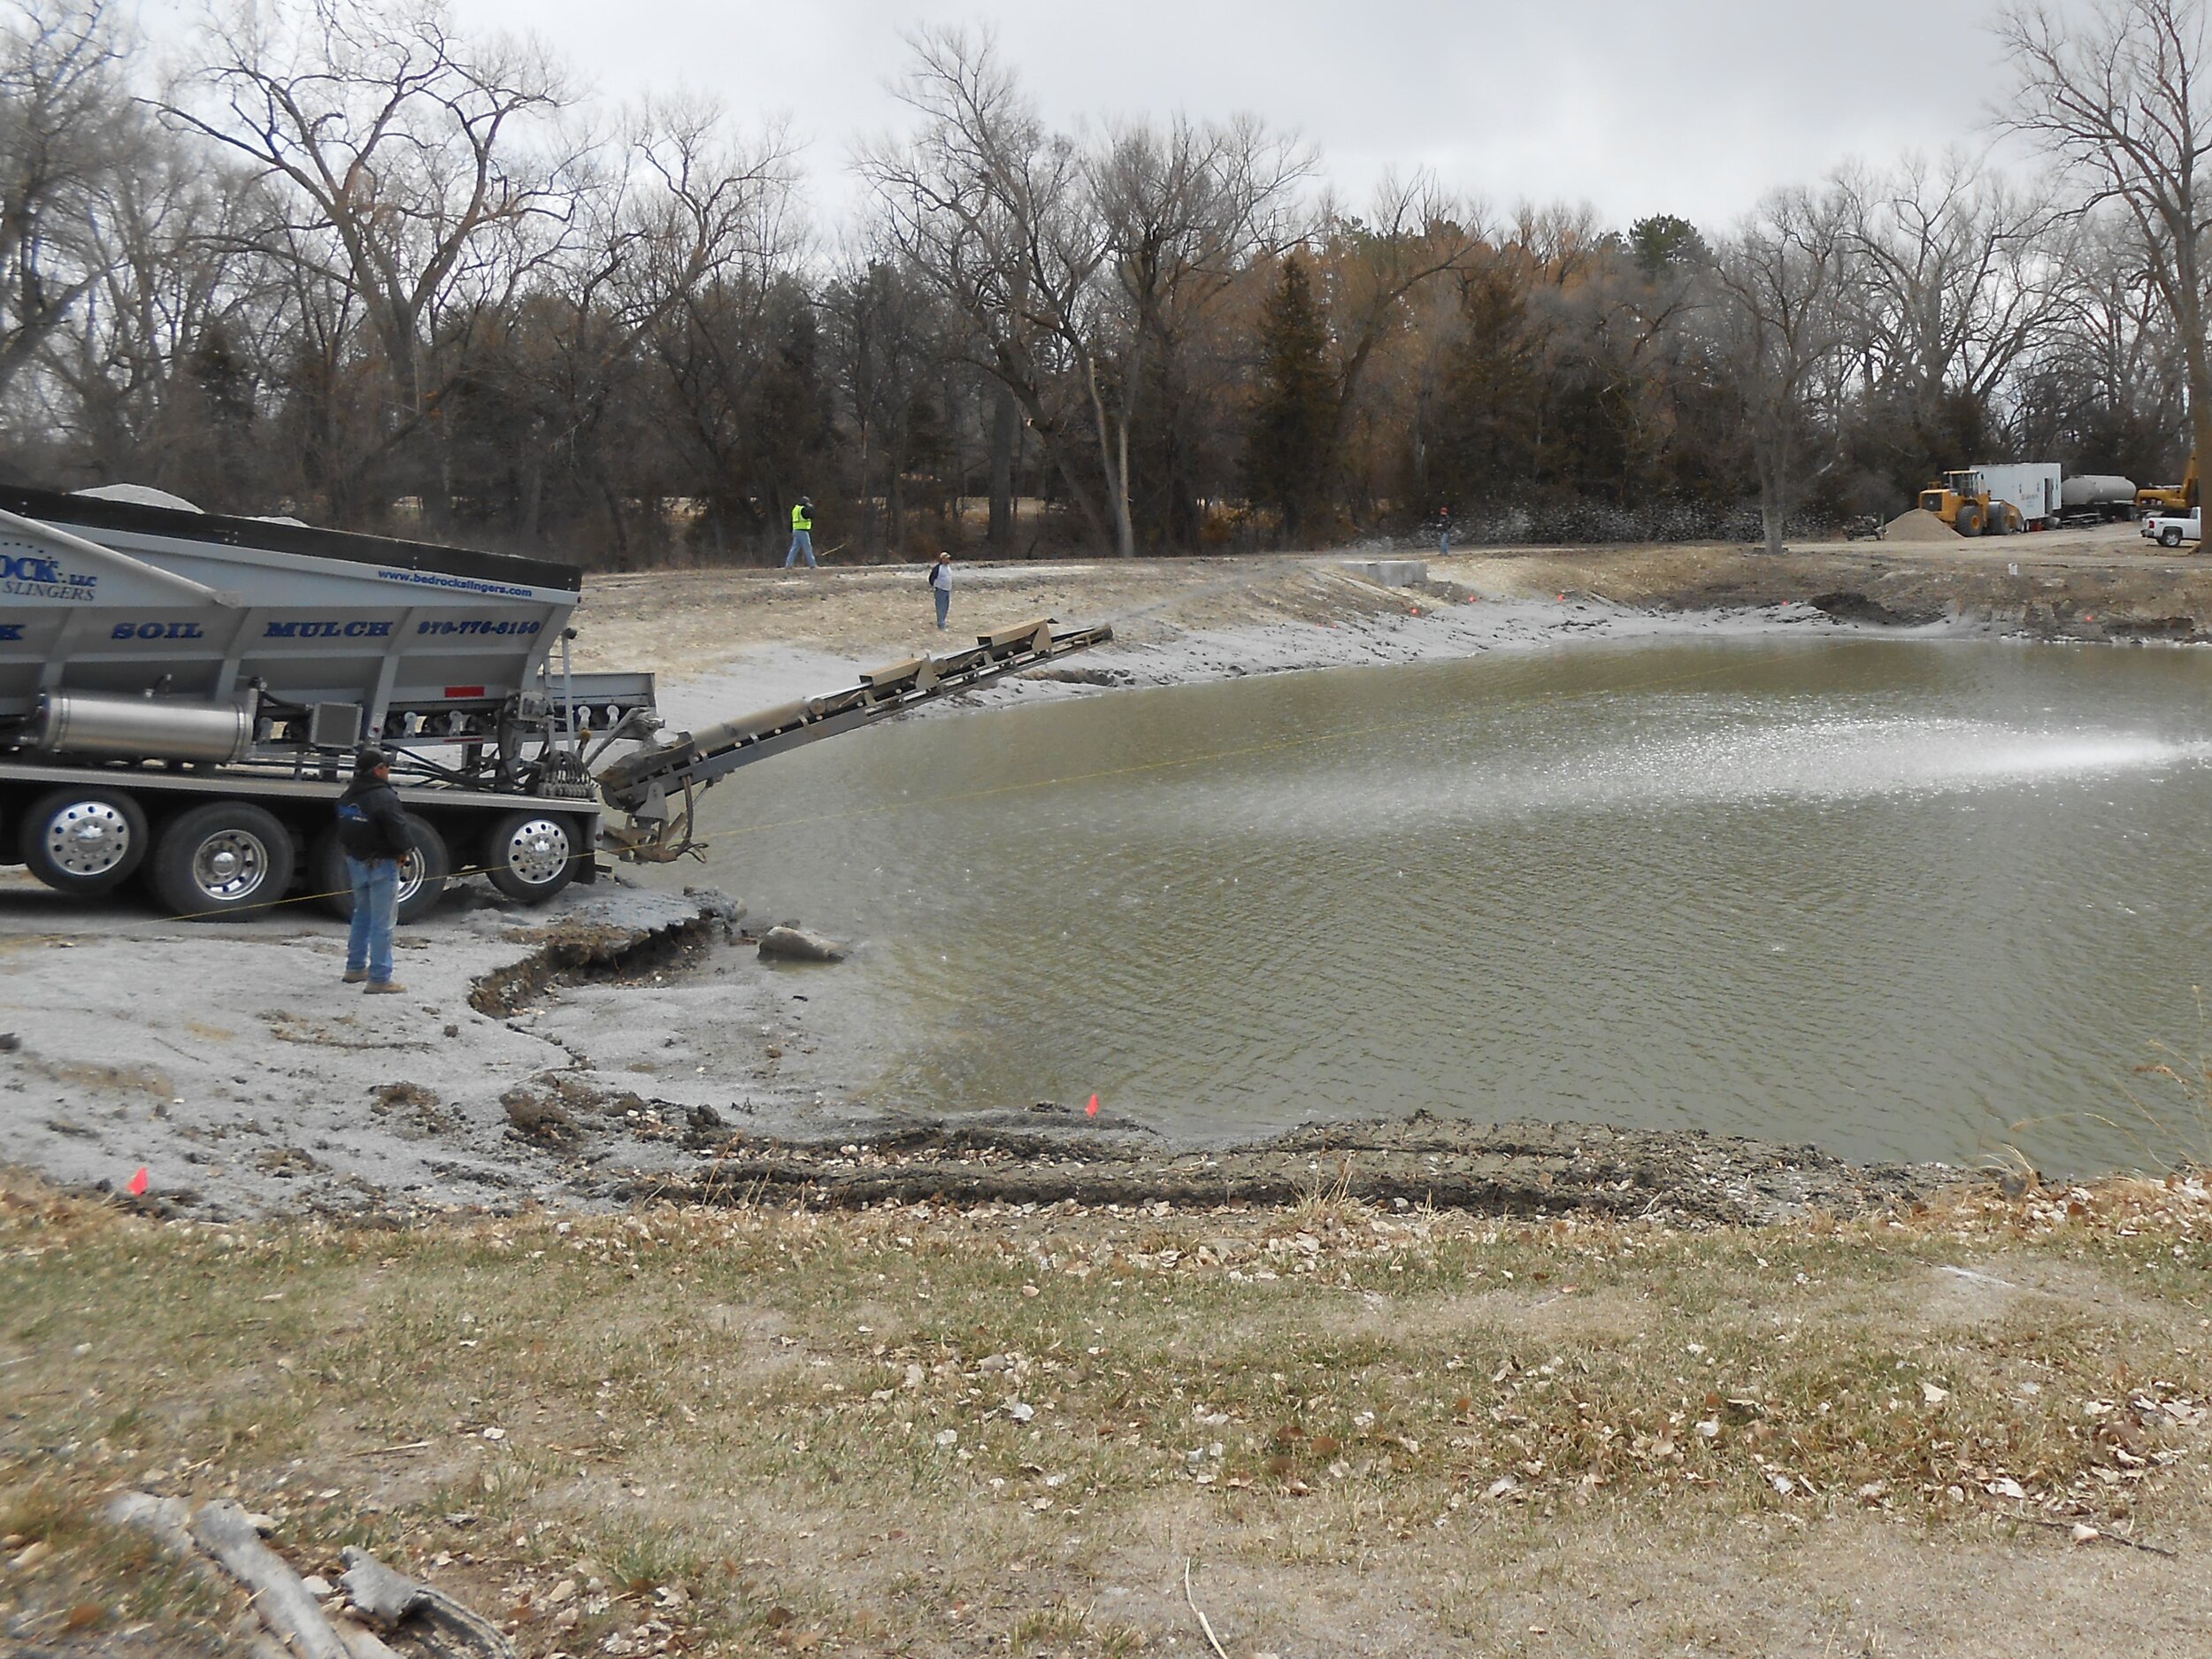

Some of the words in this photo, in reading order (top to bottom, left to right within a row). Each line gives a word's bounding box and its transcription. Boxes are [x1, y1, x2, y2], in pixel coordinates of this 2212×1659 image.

[70, 574, 97, 587] LLC
[378, 571, 532, 597] www.bedrockslingers.com
[3, 580, 96, 601] SLINGERS
[111, 622, 204, 639] SOIL
[263, 621, 394, 638] MULCH
